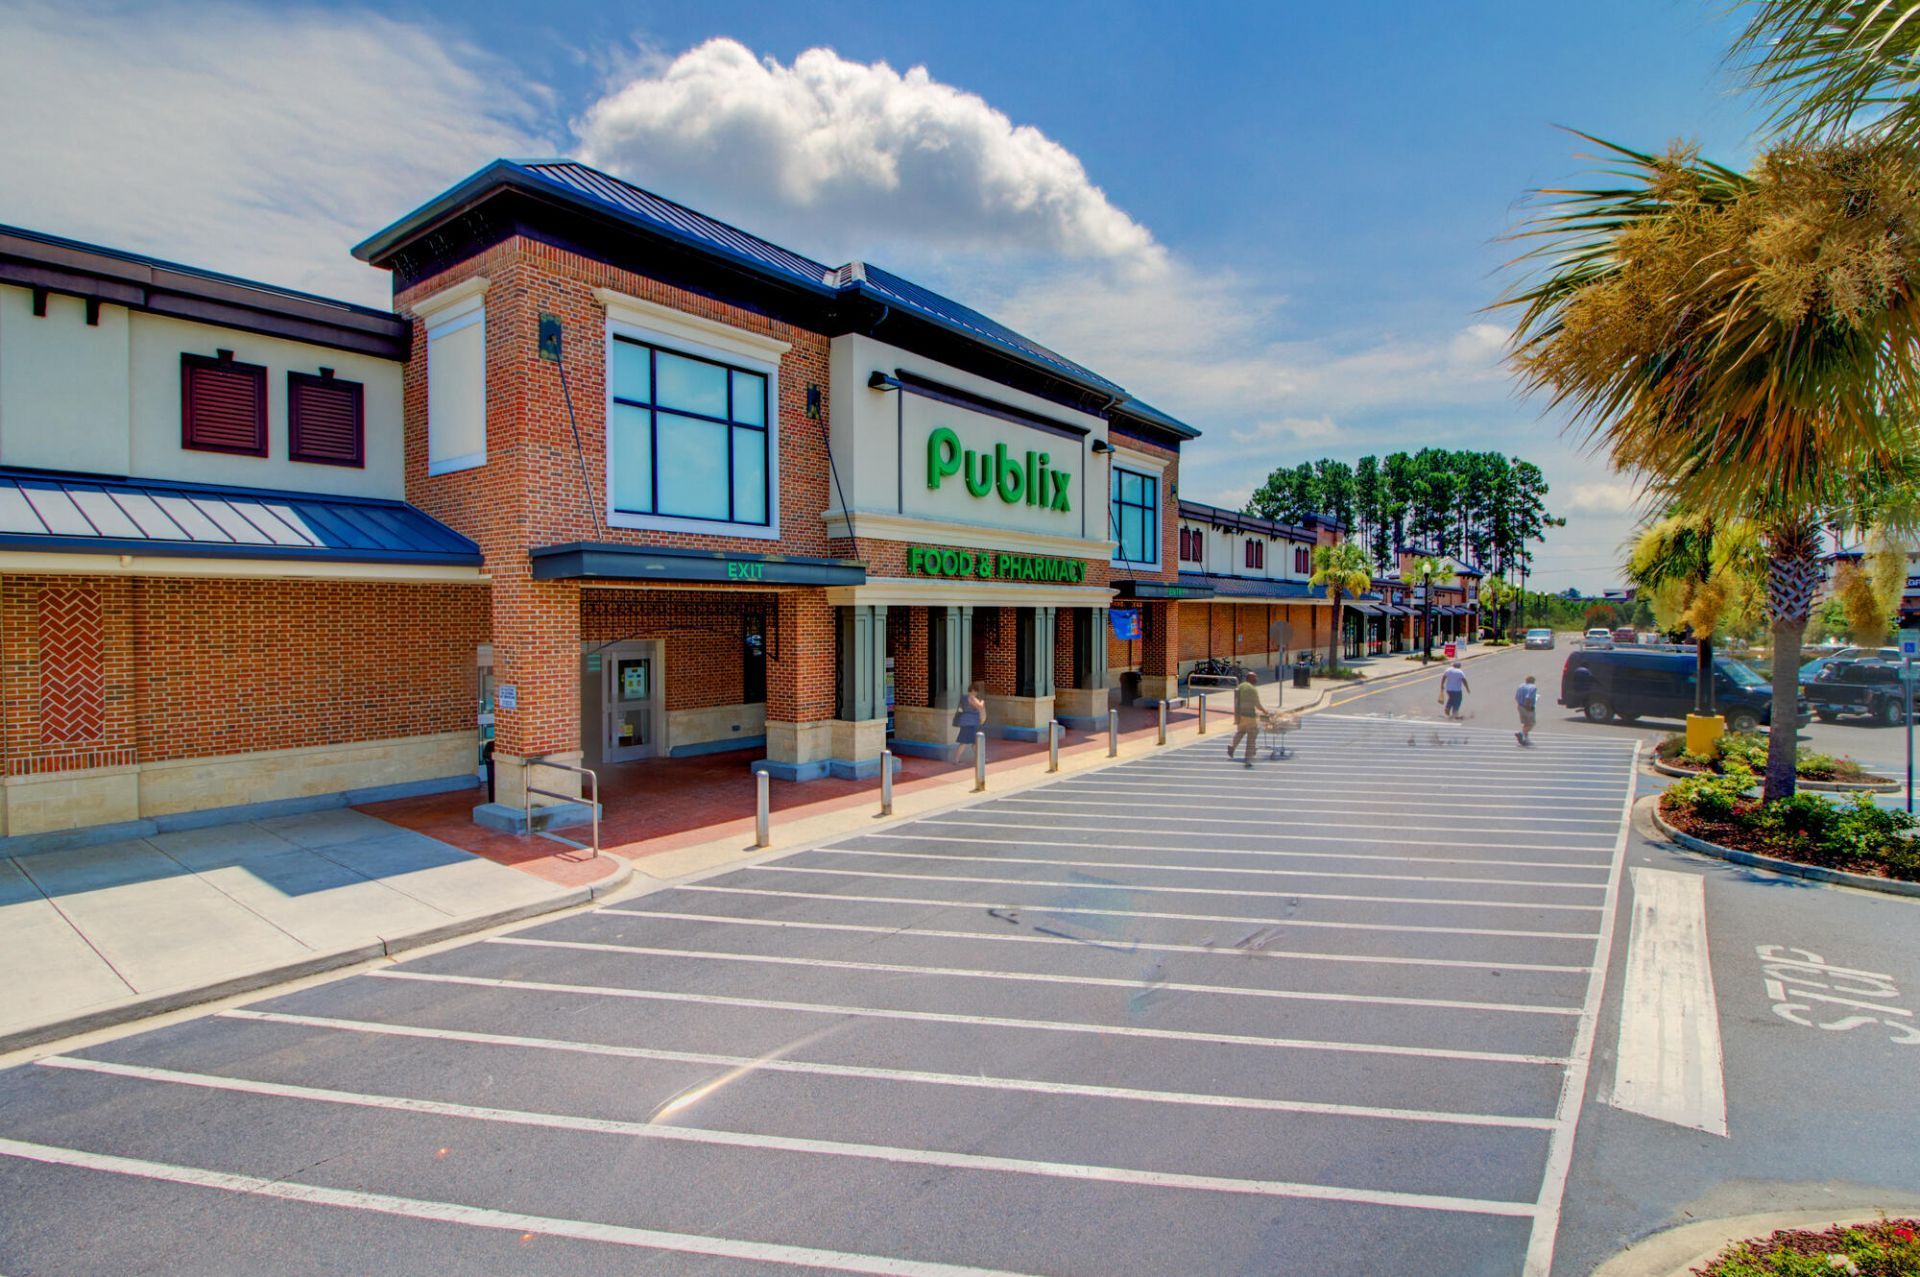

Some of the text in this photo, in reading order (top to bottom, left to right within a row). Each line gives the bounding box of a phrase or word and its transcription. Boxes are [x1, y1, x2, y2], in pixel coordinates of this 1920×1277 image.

[927, 427, 1071, 512] Publix
[727, 561, 764, 578] EXIT
[908, 547, 1088, 583] FOOD & PHARMACY
